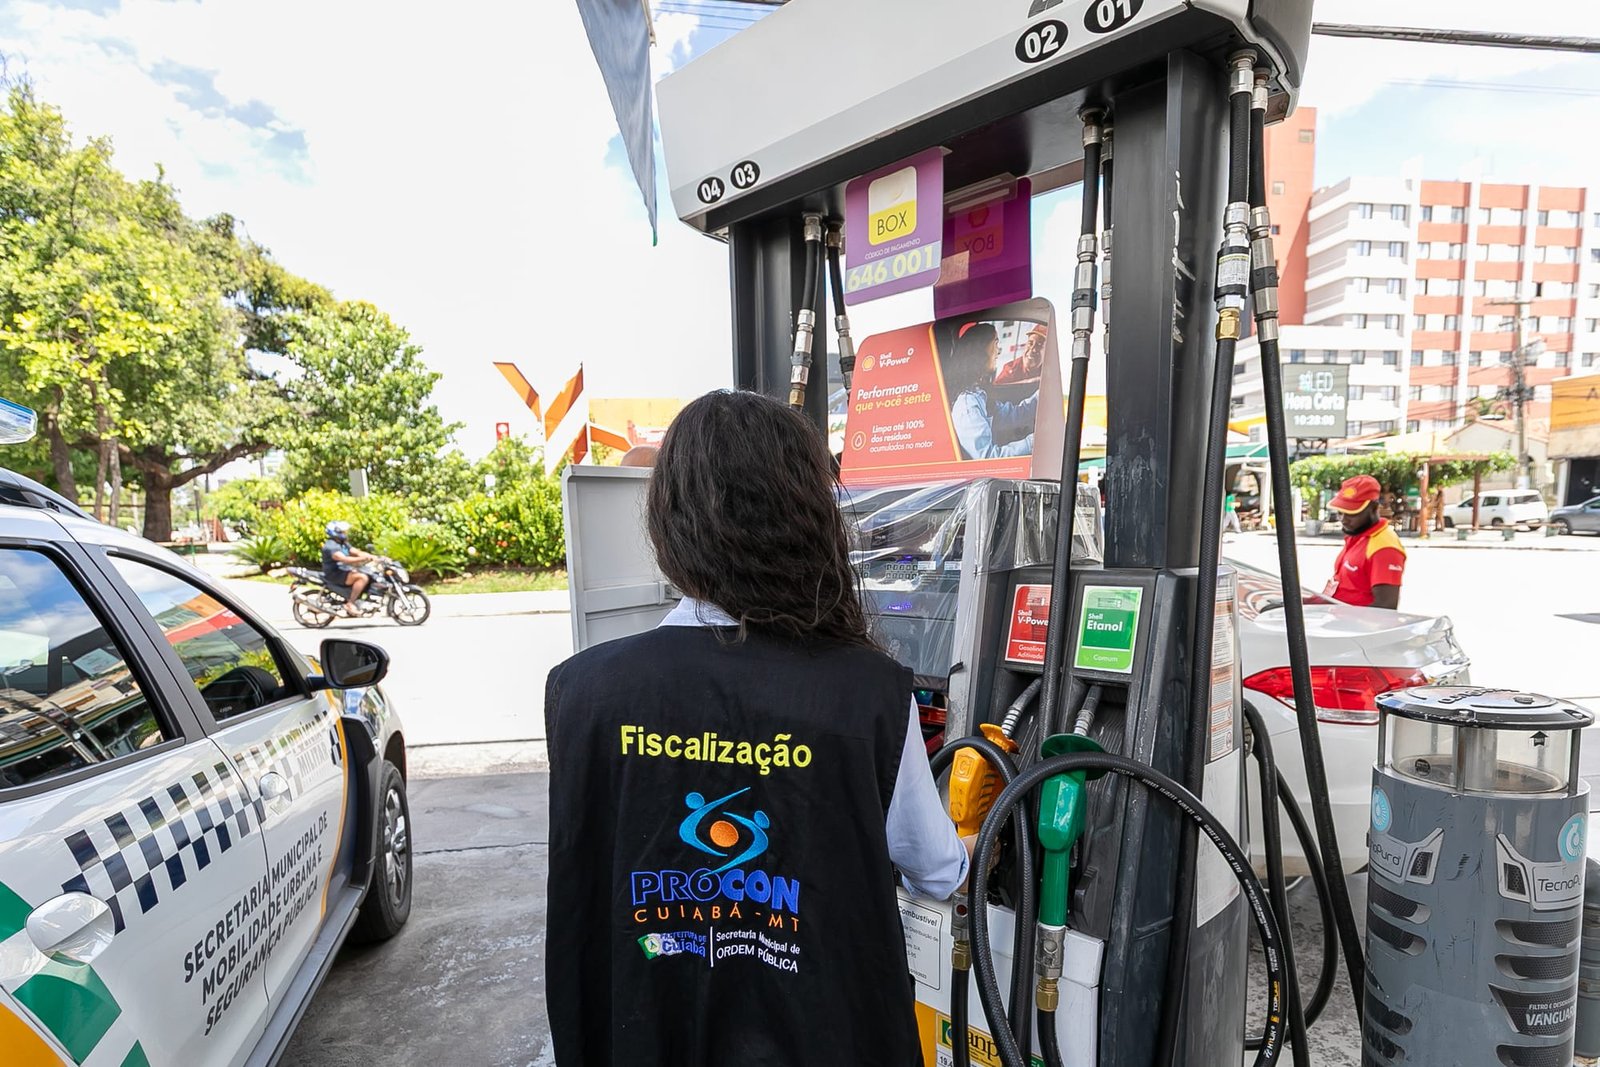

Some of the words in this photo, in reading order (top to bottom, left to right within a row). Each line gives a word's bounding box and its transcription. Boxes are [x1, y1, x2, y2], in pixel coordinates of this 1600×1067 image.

[1096, 0, 1132, 28] 01
[1024, 24, 1059, 59] 02
[734, 163, 756, 187] 03
[701, 178, 721, 202] 04
[877, 210, 907, 236] BOX
[890, 238, 921, 251] PAGAMENTO
[847, 261, 888, 290] 646
[893, 245, 934, 279] 001
[879, 352, 892, 360] Shell
[879, 356, 910, 368] V-Power
[857, 382, 919, 400] Performance
[1284, 392, 1312, 410] Hora
[1313, 392, 1345, 411] Certa
[855, 400, 873, 414] que
[904, 391, 931, 406] sente
[871, 434, 883, 443] dos
[883, 431, 912, 442] resíduos
[872, 425, 891, 435] Limpa
[893, 421, 905, 431] até
[906, 419, 925, 430] 100%
[869, 442, 905, 453] acumulados
[914, 440, 934, 449] motor
[1017, 609, 1033, 617] Shell
[1018, 616, 1049, 627] V-Powe
[1086, 619, 1123, 632] Etanol
[1018, 644, 1044, 653] Gasolina
[1093, 654, 1118, 663] Comum
[621, 725, 812, 776] Fiscalização
[184, 875, 270, 984] SECRETARIA
[271, 826, 319, 889] MUNICIPAL
[317, 810, 329, 839] DE
[631, 867, 800, 915] PROCON
[202, 893, 282, 1006] MOBILIDADE
[283, 852, 317, 909] URBANA
[316, 843, 323, 864] E
[634, 902, 742, 923] CUIABÁ
[768, 913, 799, 932] MT
[662, 938, 706, 958] Cuiabá
[716, 929, 757, 942] Secretaria
[758, 931, 788, 953] Municipal
[790, 944, 801, 955] de
[204, 926, 282, 1037] SEGURANÇA
[282, 875, 318, 935] PÚBLICA
[716, 944, 755, 959] ORDEM
[757, 948, 798, 974] PÚBLICA
[1525, 1004, 1575, 1026] VANGUAR
[1528, 1003, 1549, 1011] FILTRO
